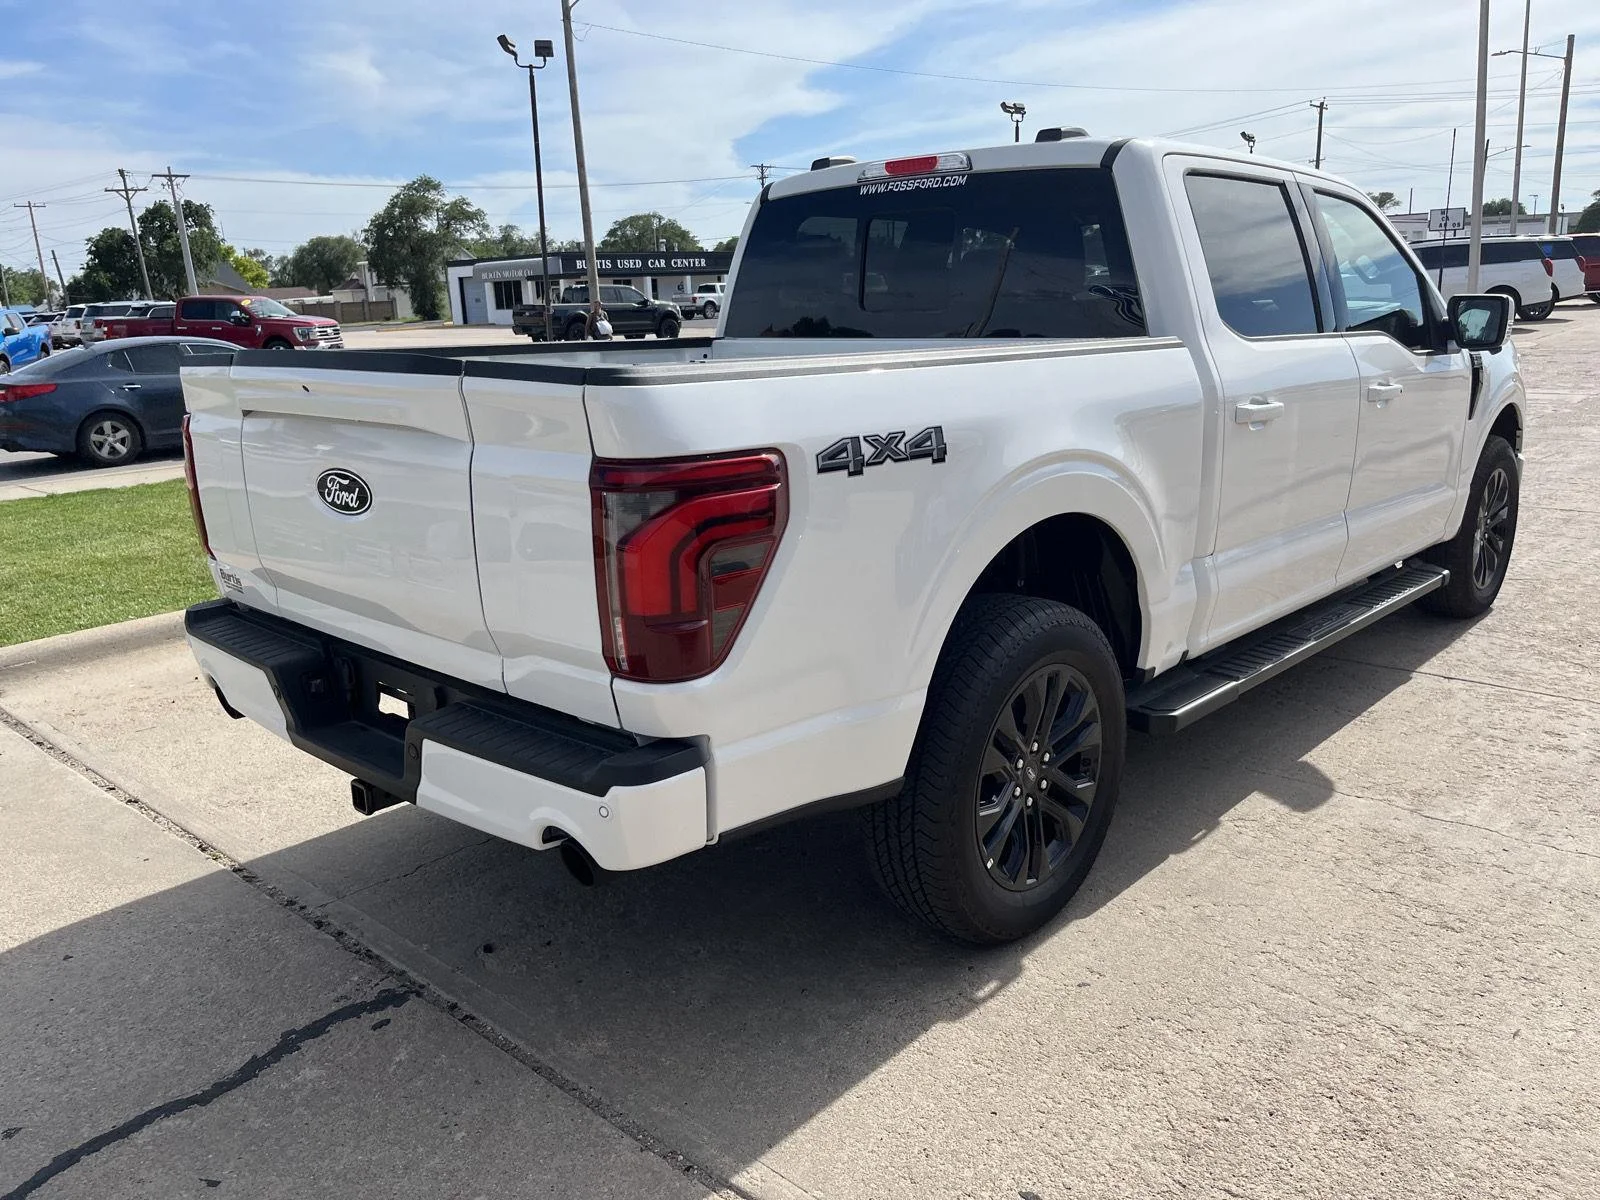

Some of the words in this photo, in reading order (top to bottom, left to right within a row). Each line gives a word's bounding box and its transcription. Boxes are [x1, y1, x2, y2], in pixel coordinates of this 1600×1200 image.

[860, 175, 968, 195] WWW.FOSSFORD.COM
[576, 259, 612, 269] BUTIS
[617, 259, 642, 269] USED
[648, 258, 667, 268] CAR
[671, 258, 707, 268] CENTER
[324, 475, 360, 508] Ford
[219, 567, 243, 587] Burtis
